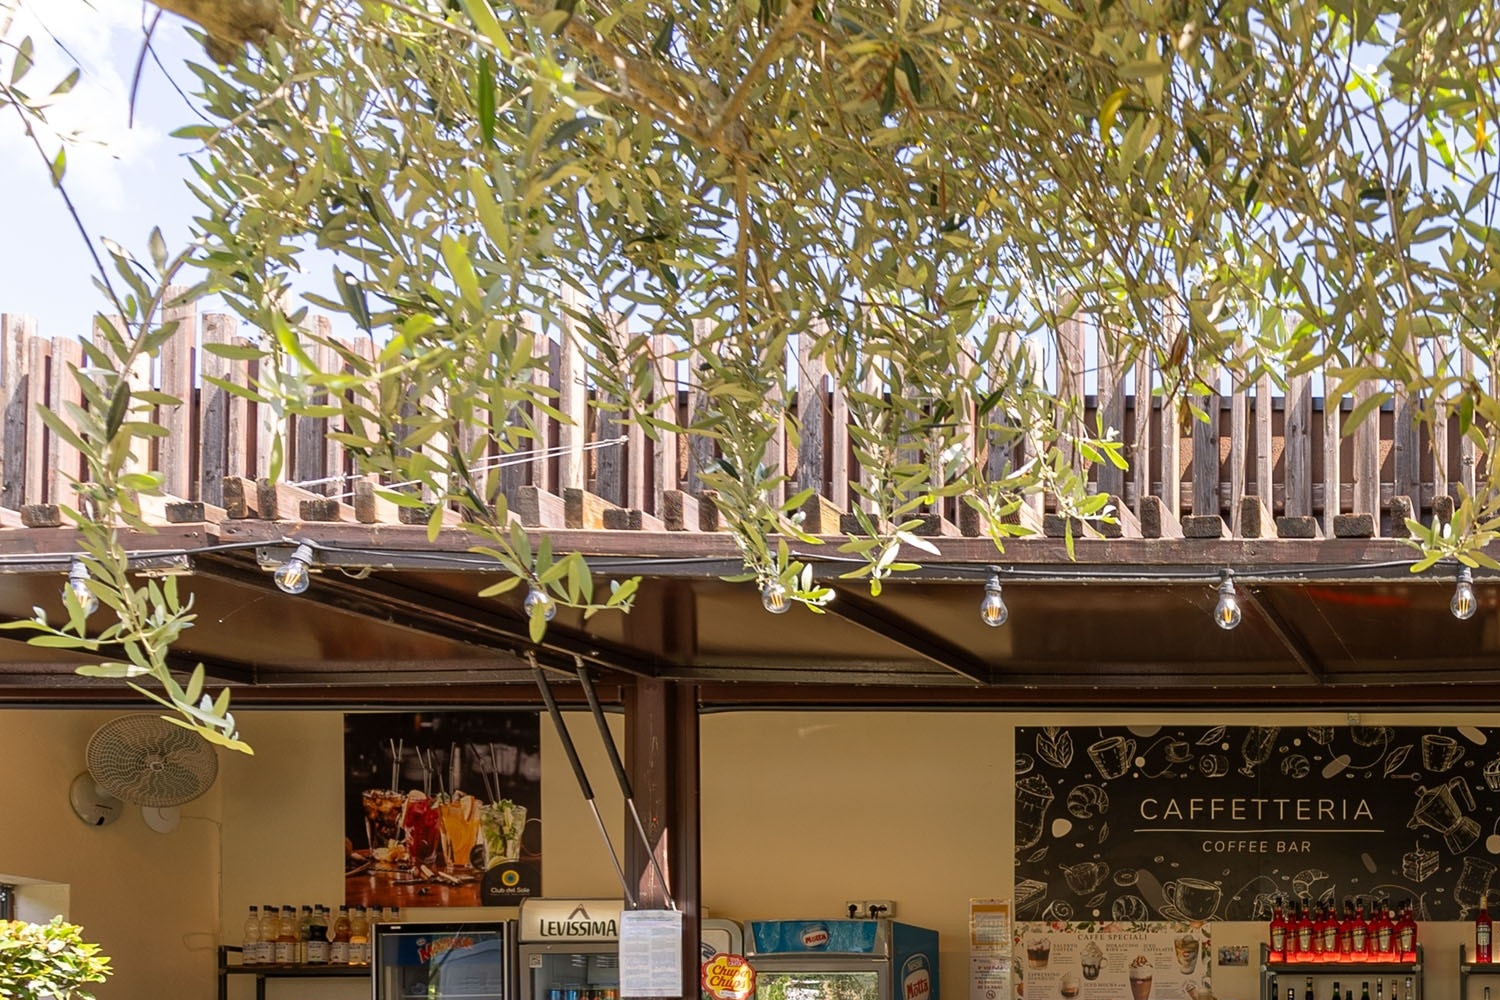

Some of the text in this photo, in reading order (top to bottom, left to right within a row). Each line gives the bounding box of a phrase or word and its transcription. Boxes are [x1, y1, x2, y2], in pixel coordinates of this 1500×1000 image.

[1140, 798, 1374, 821] CAFFETTERIA
[1202, 840, 1311, 854] COFFEE BAR
[540, 919, 617, 937] LEVISSIMA
[906, 978, 929, 1000] Motta
